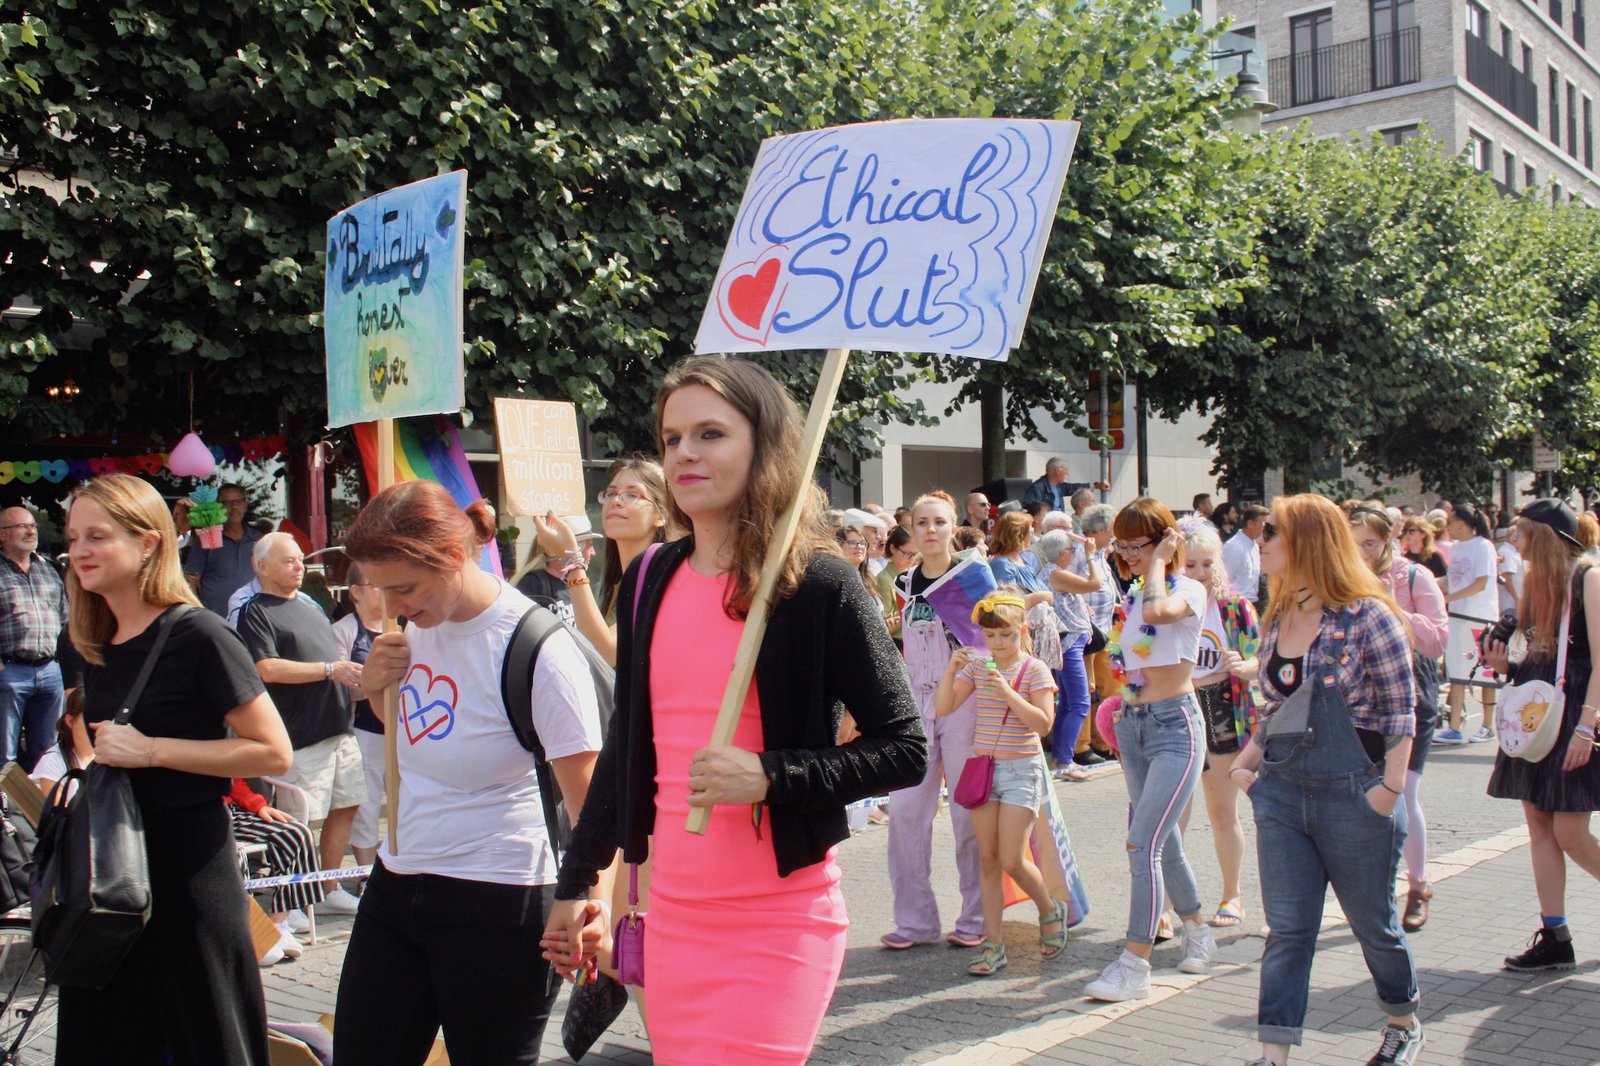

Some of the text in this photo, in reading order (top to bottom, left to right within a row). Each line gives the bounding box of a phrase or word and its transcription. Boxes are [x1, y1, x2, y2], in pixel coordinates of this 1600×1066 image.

[762, 142, 998, 244] Ethical
[340, 208, 429, 291] Brutally
[773, 232, 946, 334] Slut
[357, 287, 410, 336] honest
[498, 402, 569, 453] LOVE can
[542, 424, 576, 449] tell a
[511, 451, 574, 480] million
